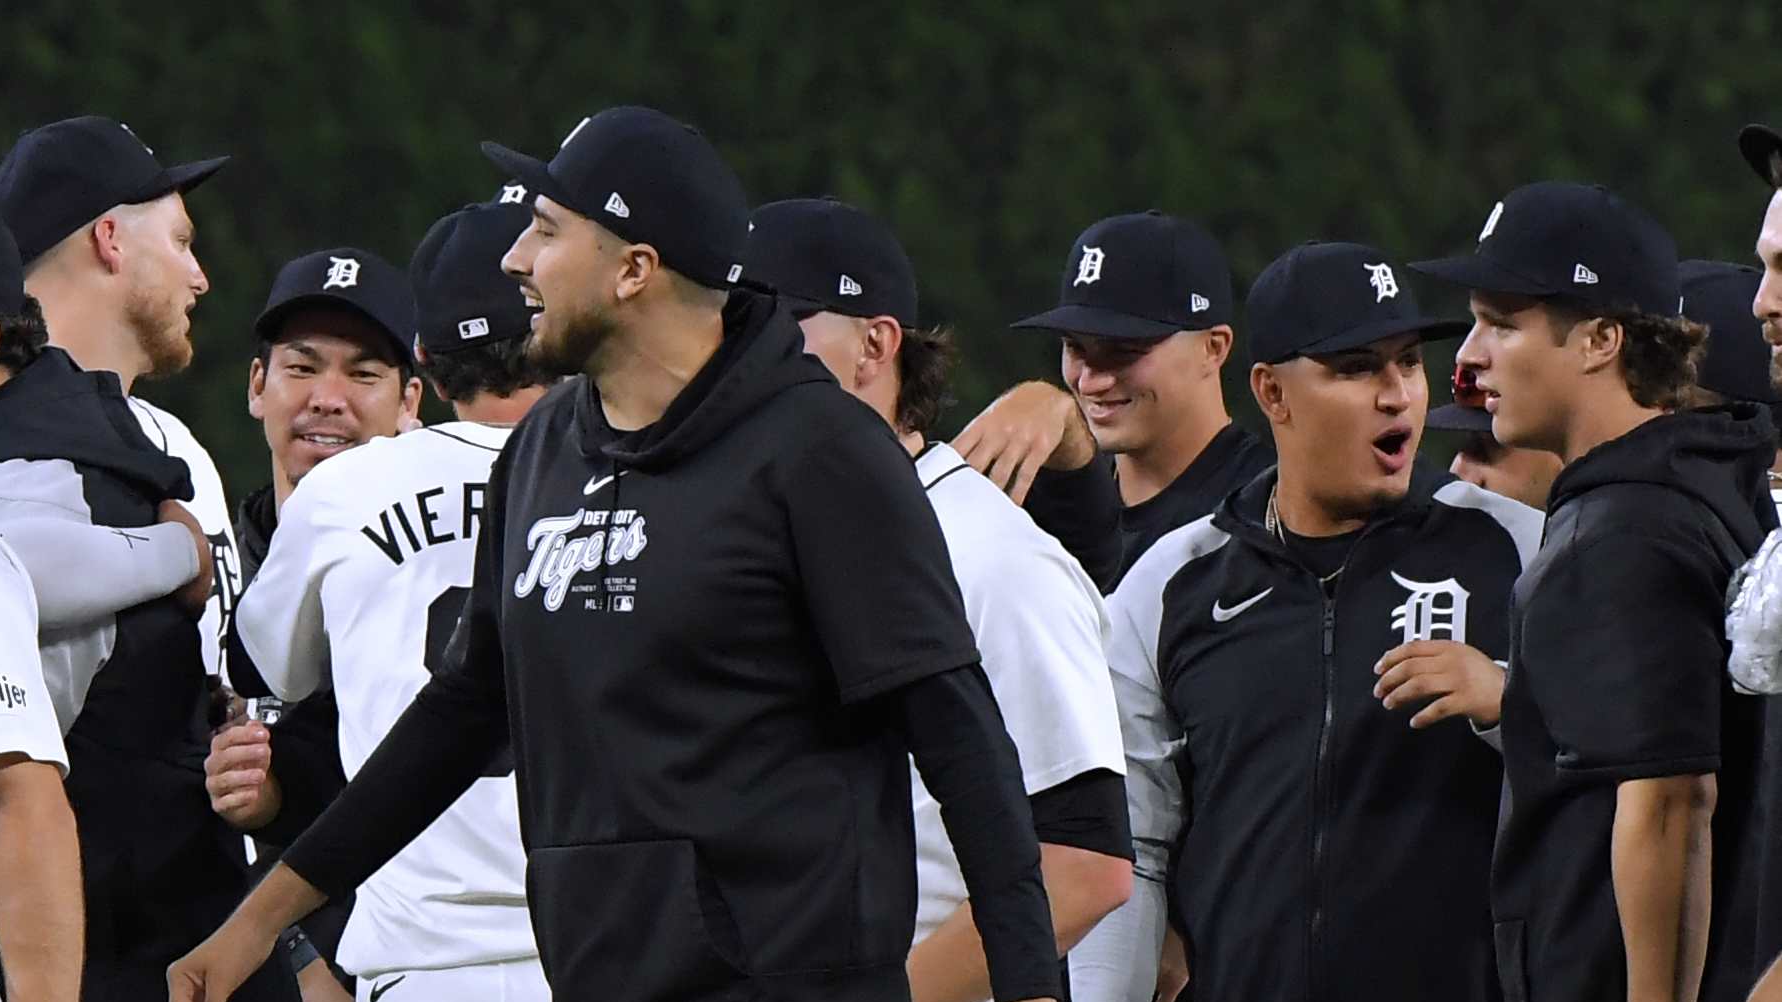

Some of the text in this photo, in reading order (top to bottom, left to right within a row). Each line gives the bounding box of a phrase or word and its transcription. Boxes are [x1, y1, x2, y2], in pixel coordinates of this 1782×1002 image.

[323, 256, 360, 290] D
[1073, 245, 1105, 287] D
[1364, 262, 1399, 303] D
[514, 508, 647, 612] Tigers
